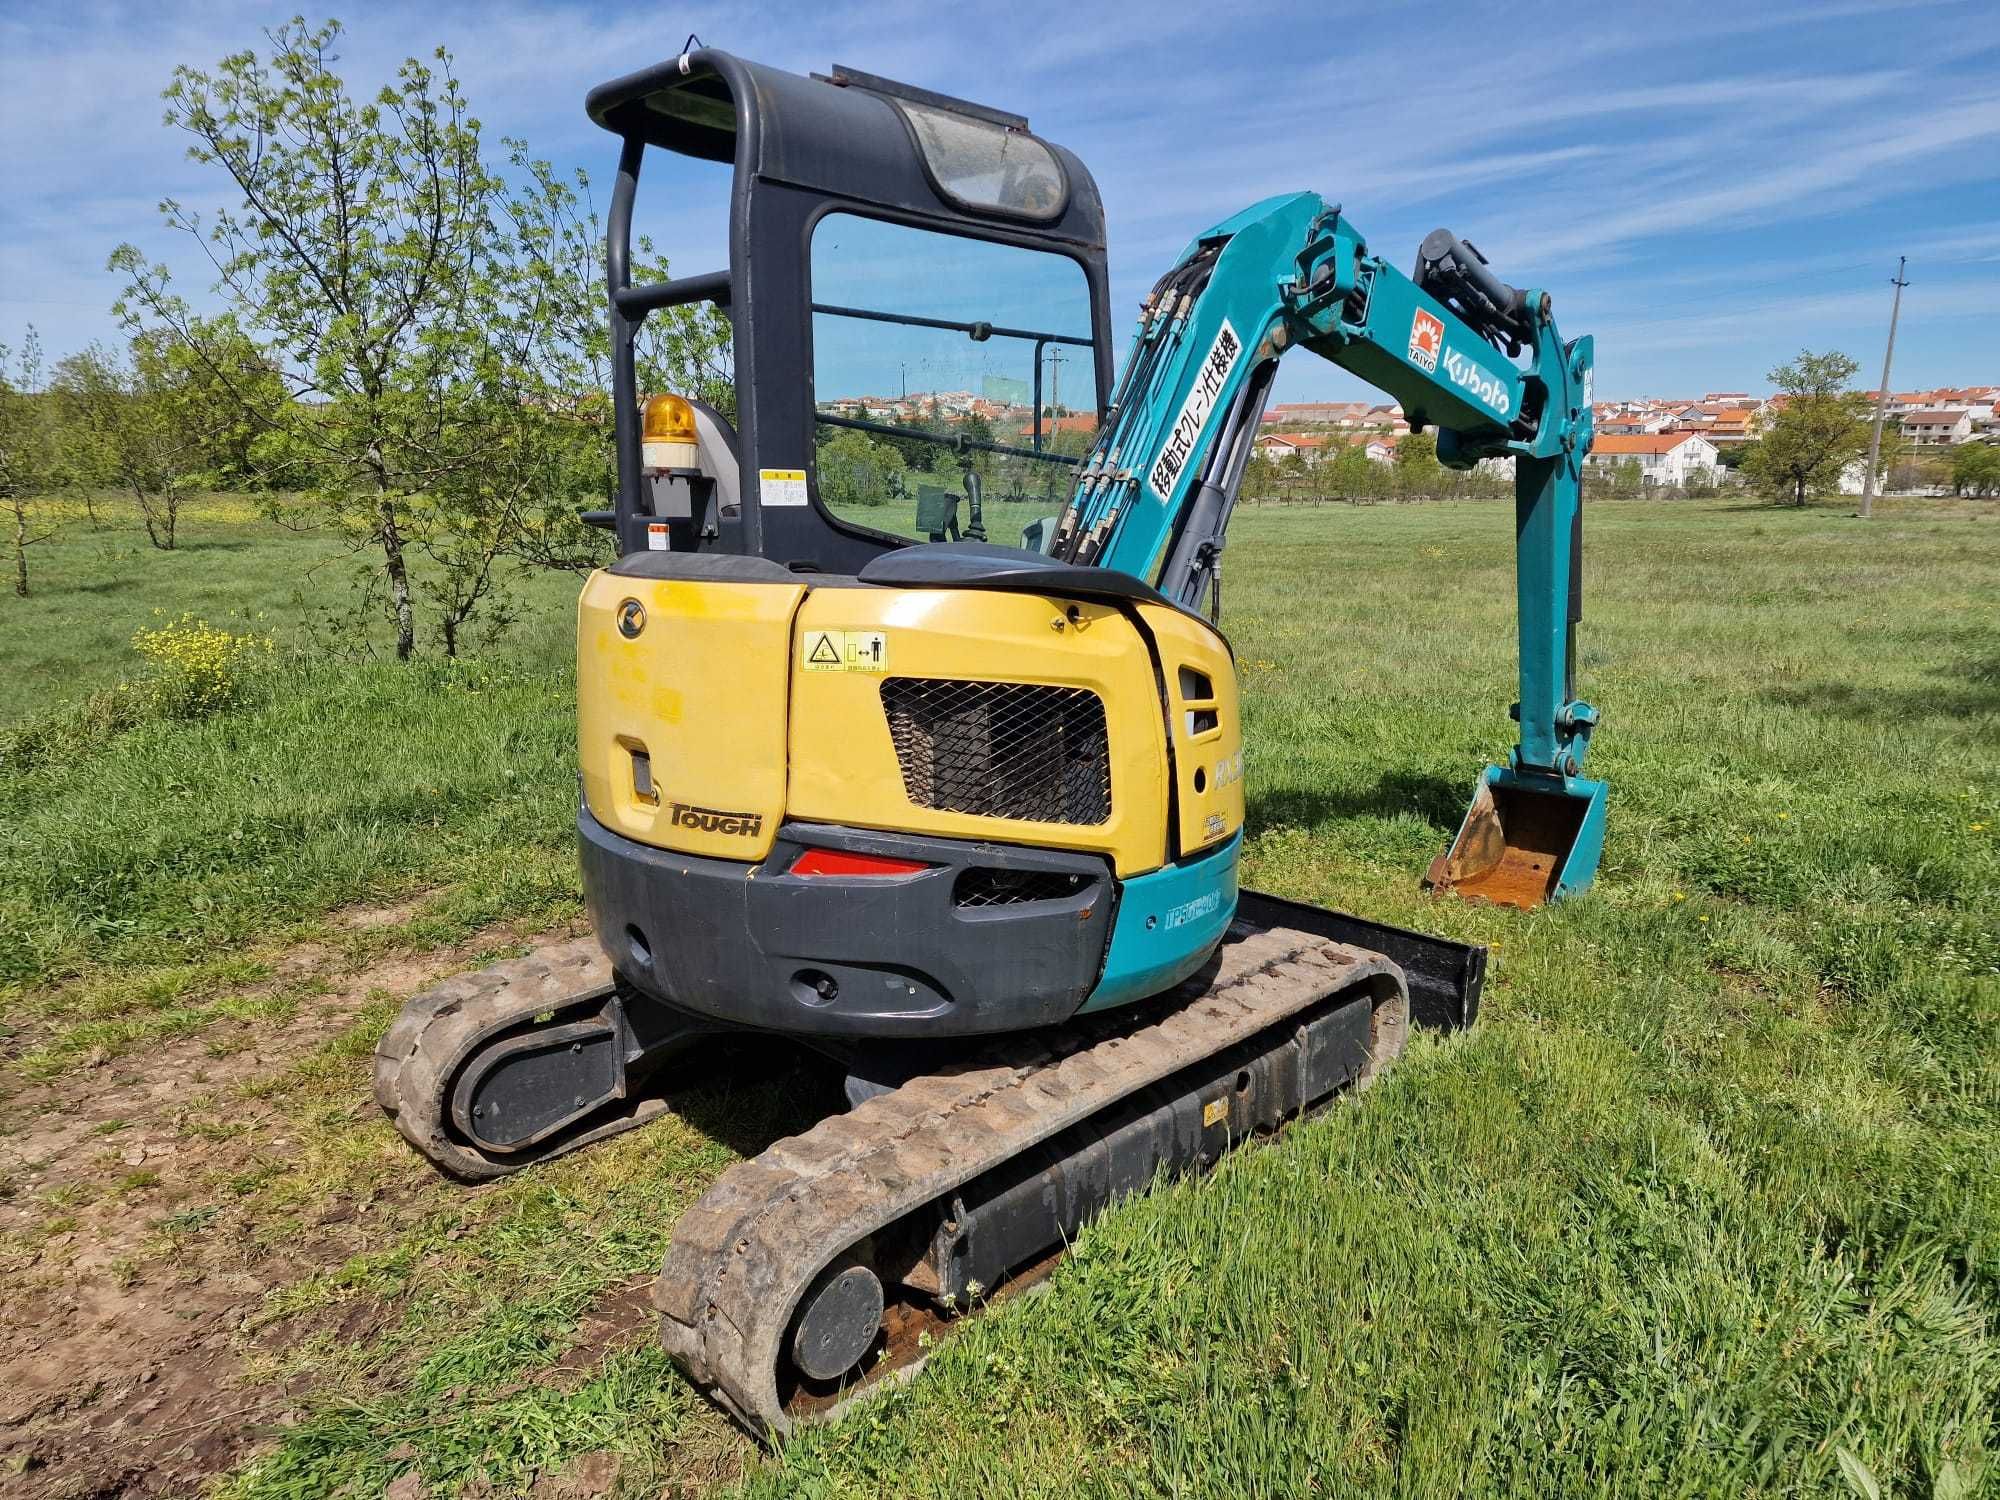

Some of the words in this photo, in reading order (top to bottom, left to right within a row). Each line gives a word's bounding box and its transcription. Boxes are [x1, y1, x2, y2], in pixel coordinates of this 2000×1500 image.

[1409, 348, 1435, 372] TAIYO
[1442, 345, 1510, 415] Kubota
[1152, 328, 1238, 497] 移動式クレーン仕様機
[667, 801, 763, 838] TOUGH
